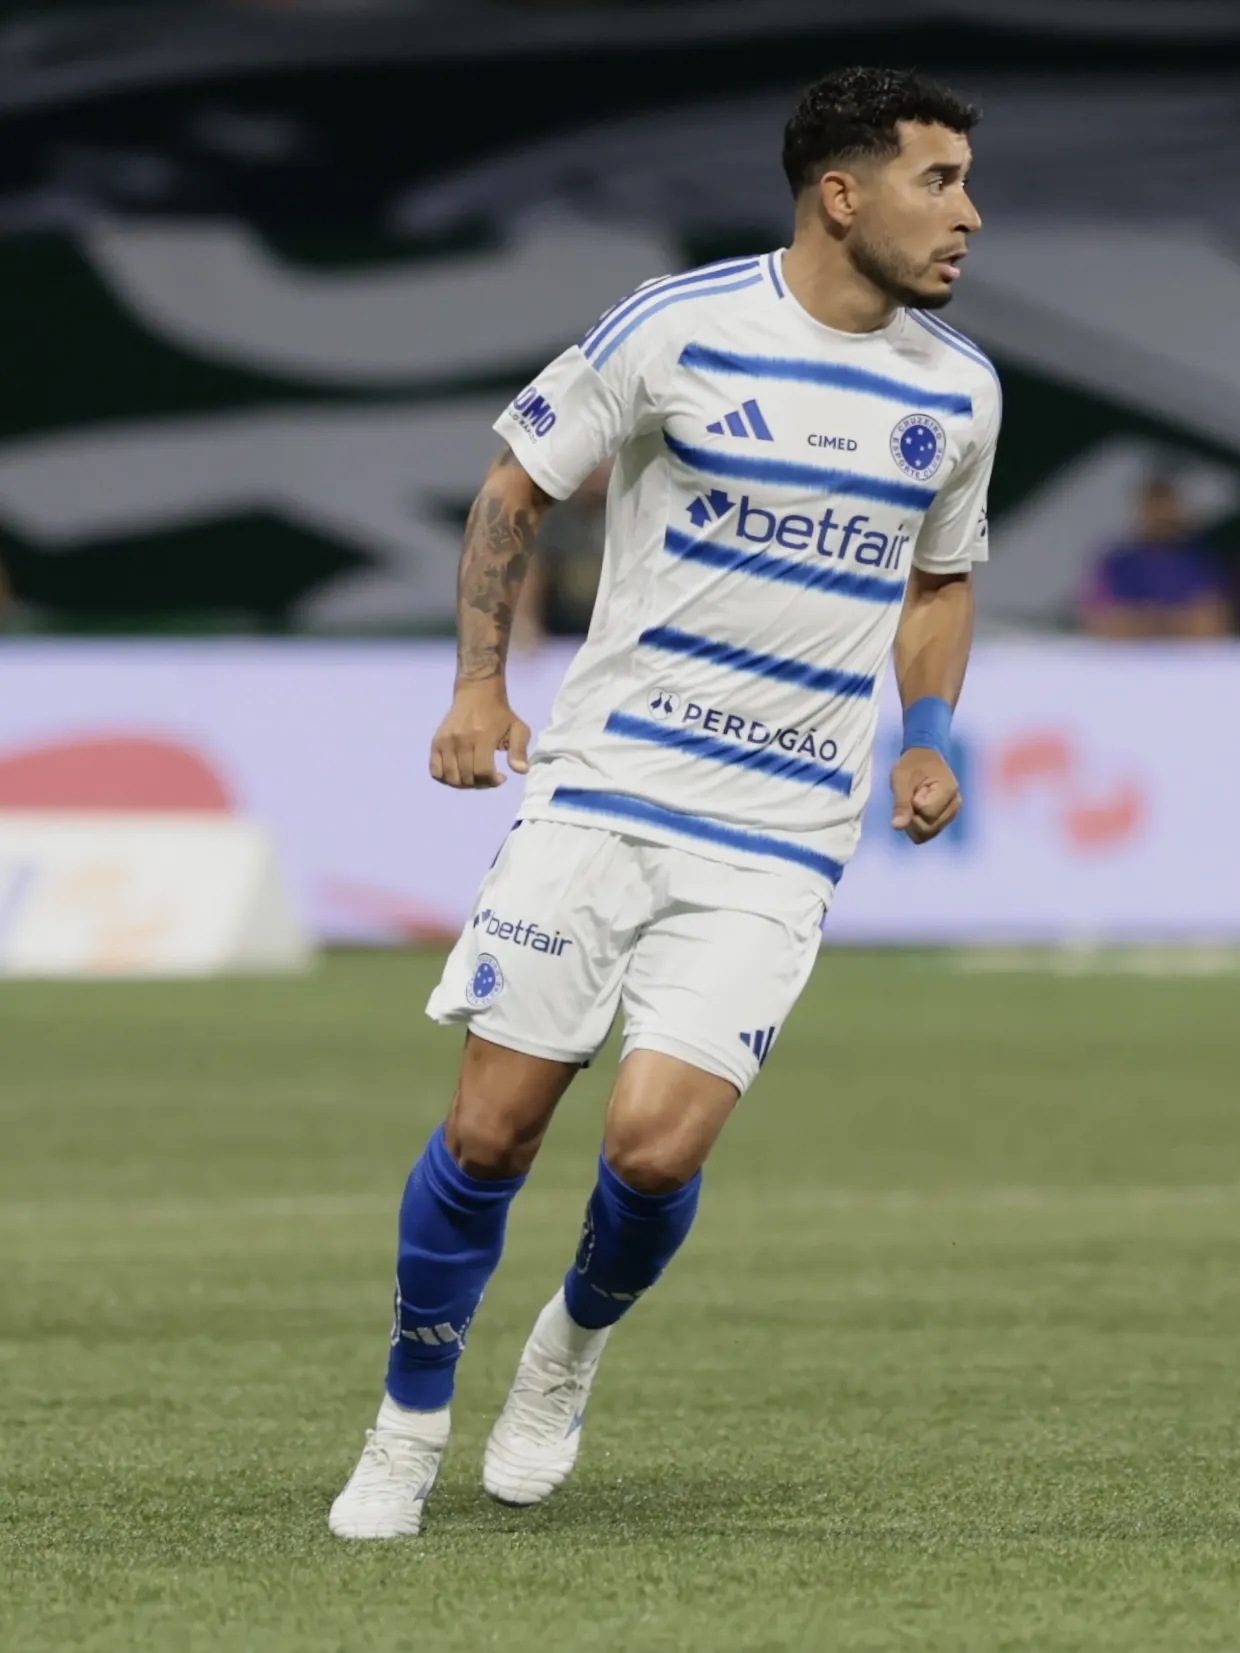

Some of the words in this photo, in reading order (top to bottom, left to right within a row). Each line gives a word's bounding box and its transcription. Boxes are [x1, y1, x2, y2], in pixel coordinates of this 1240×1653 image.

[807, 434, 858, 451] CIMED
[898, 416, 942, 440] CRUZEIRO
[893, 437, 920, 478] ESPORTE
[736, 495, 910, 570] betfair
[682, 703, 838, 762] PERDIGÃO
[485, 911, 573, 956] betfair
